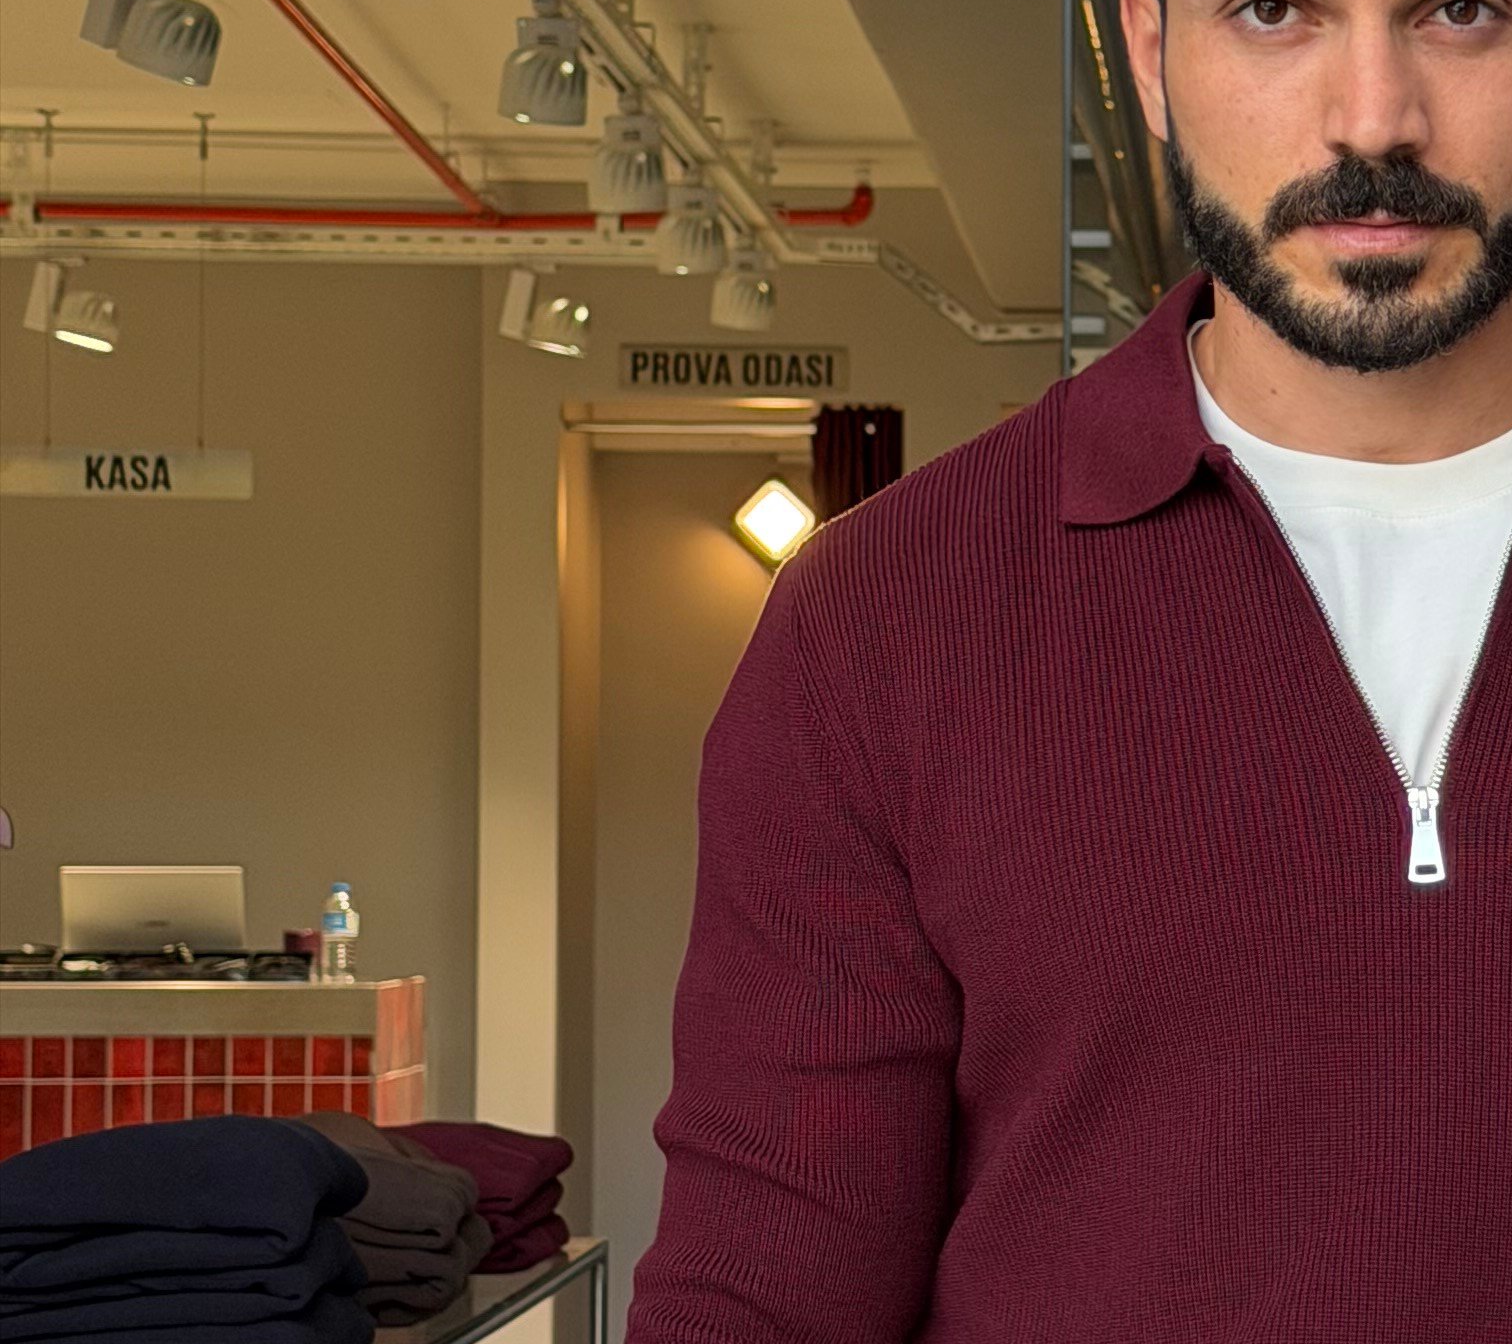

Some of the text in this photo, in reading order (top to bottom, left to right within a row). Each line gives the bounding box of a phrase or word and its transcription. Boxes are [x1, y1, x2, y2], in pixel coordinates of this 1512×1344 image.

[631, 351, 834, 387] PROVA ODASI
[85, 455, 171, 490] KASA
